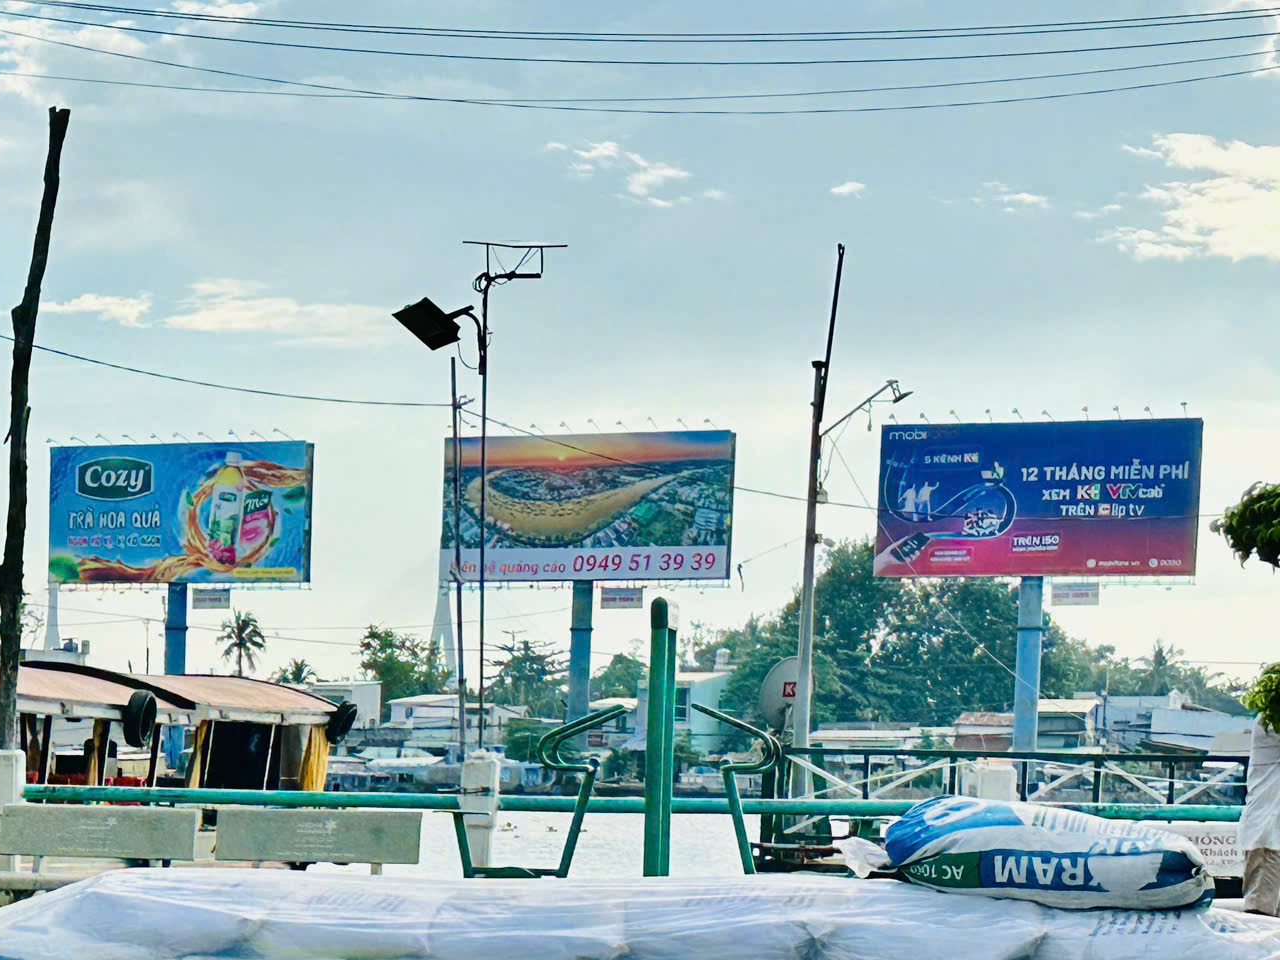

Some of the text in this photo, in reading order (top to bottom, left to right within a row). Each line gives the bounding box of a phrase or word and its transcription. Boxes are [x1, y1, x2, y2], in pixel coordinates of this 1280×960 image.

[84, 465, 145, 493] Cozy
[1021, 458, 1190, 482] 12 THÁNG MIỄN PHÍ
[1042, 488, 1070, 501] XEM
[68, 503, 161, 529] TRÀ HOA QUẢ
[1060, 502, 1095, 517] TRÊN
[572, 551, 716, 573] 0949 51 39 39
[941, 864, 964, 881] AC
